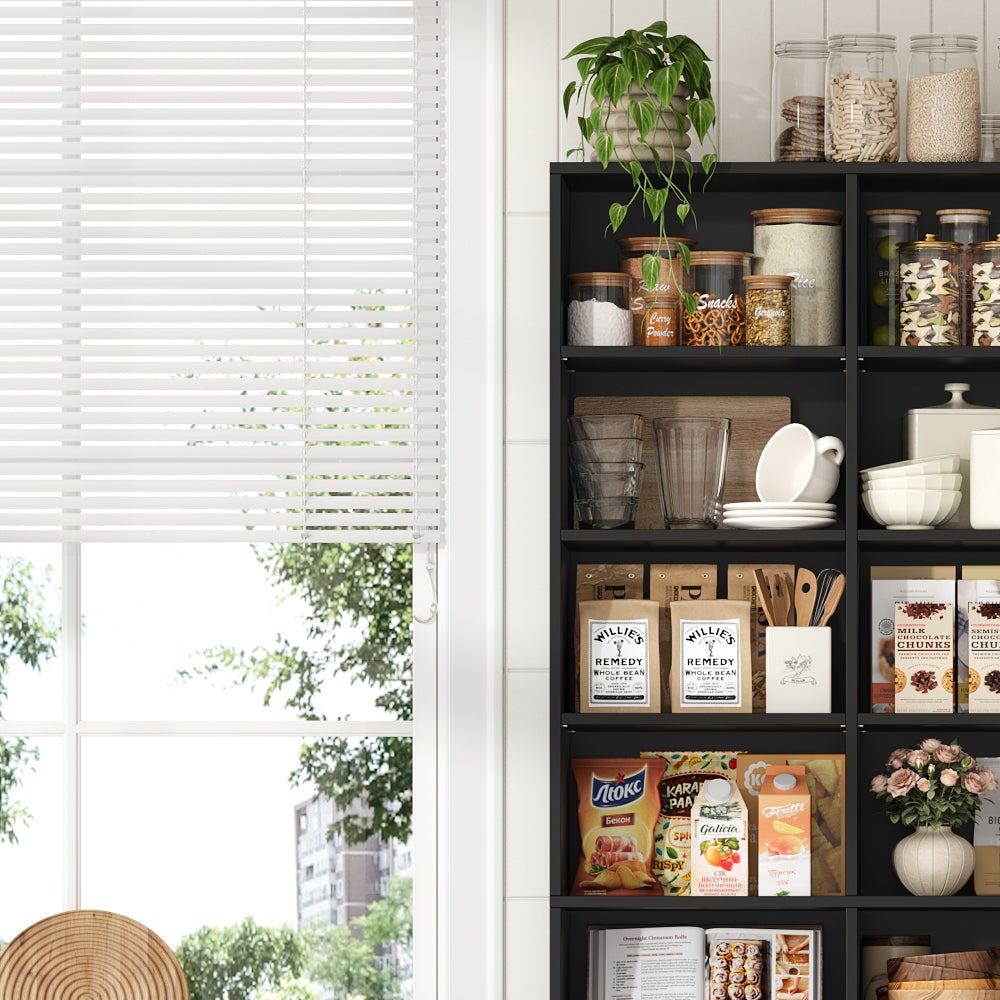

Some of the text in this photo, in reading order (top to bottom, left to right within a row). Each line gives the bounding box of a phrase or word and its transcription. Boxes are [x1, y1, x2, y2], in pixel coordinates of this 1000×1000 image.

[787, 270, 816, 290] Rice
[697, 294, 738, 310] Snacks
[650, 311, 672, 325] Curry
[647, 326, 674, 338] Powder
[594, 626, 645, 645] WILLIE'S
[686, 626, 736, 645] WILLIE'S
[897, 641, 951, 649] CHUNKS
[596, 658, 642, 666] REMEDY
[688, 658, 734, 666] REMEDY
[593, 780, 642, 803] Люкс
[761, 801, 805, 819] Frutti
[605, 816, 631, 825] Бекон
[700, 823, 741, 835] Galicia
